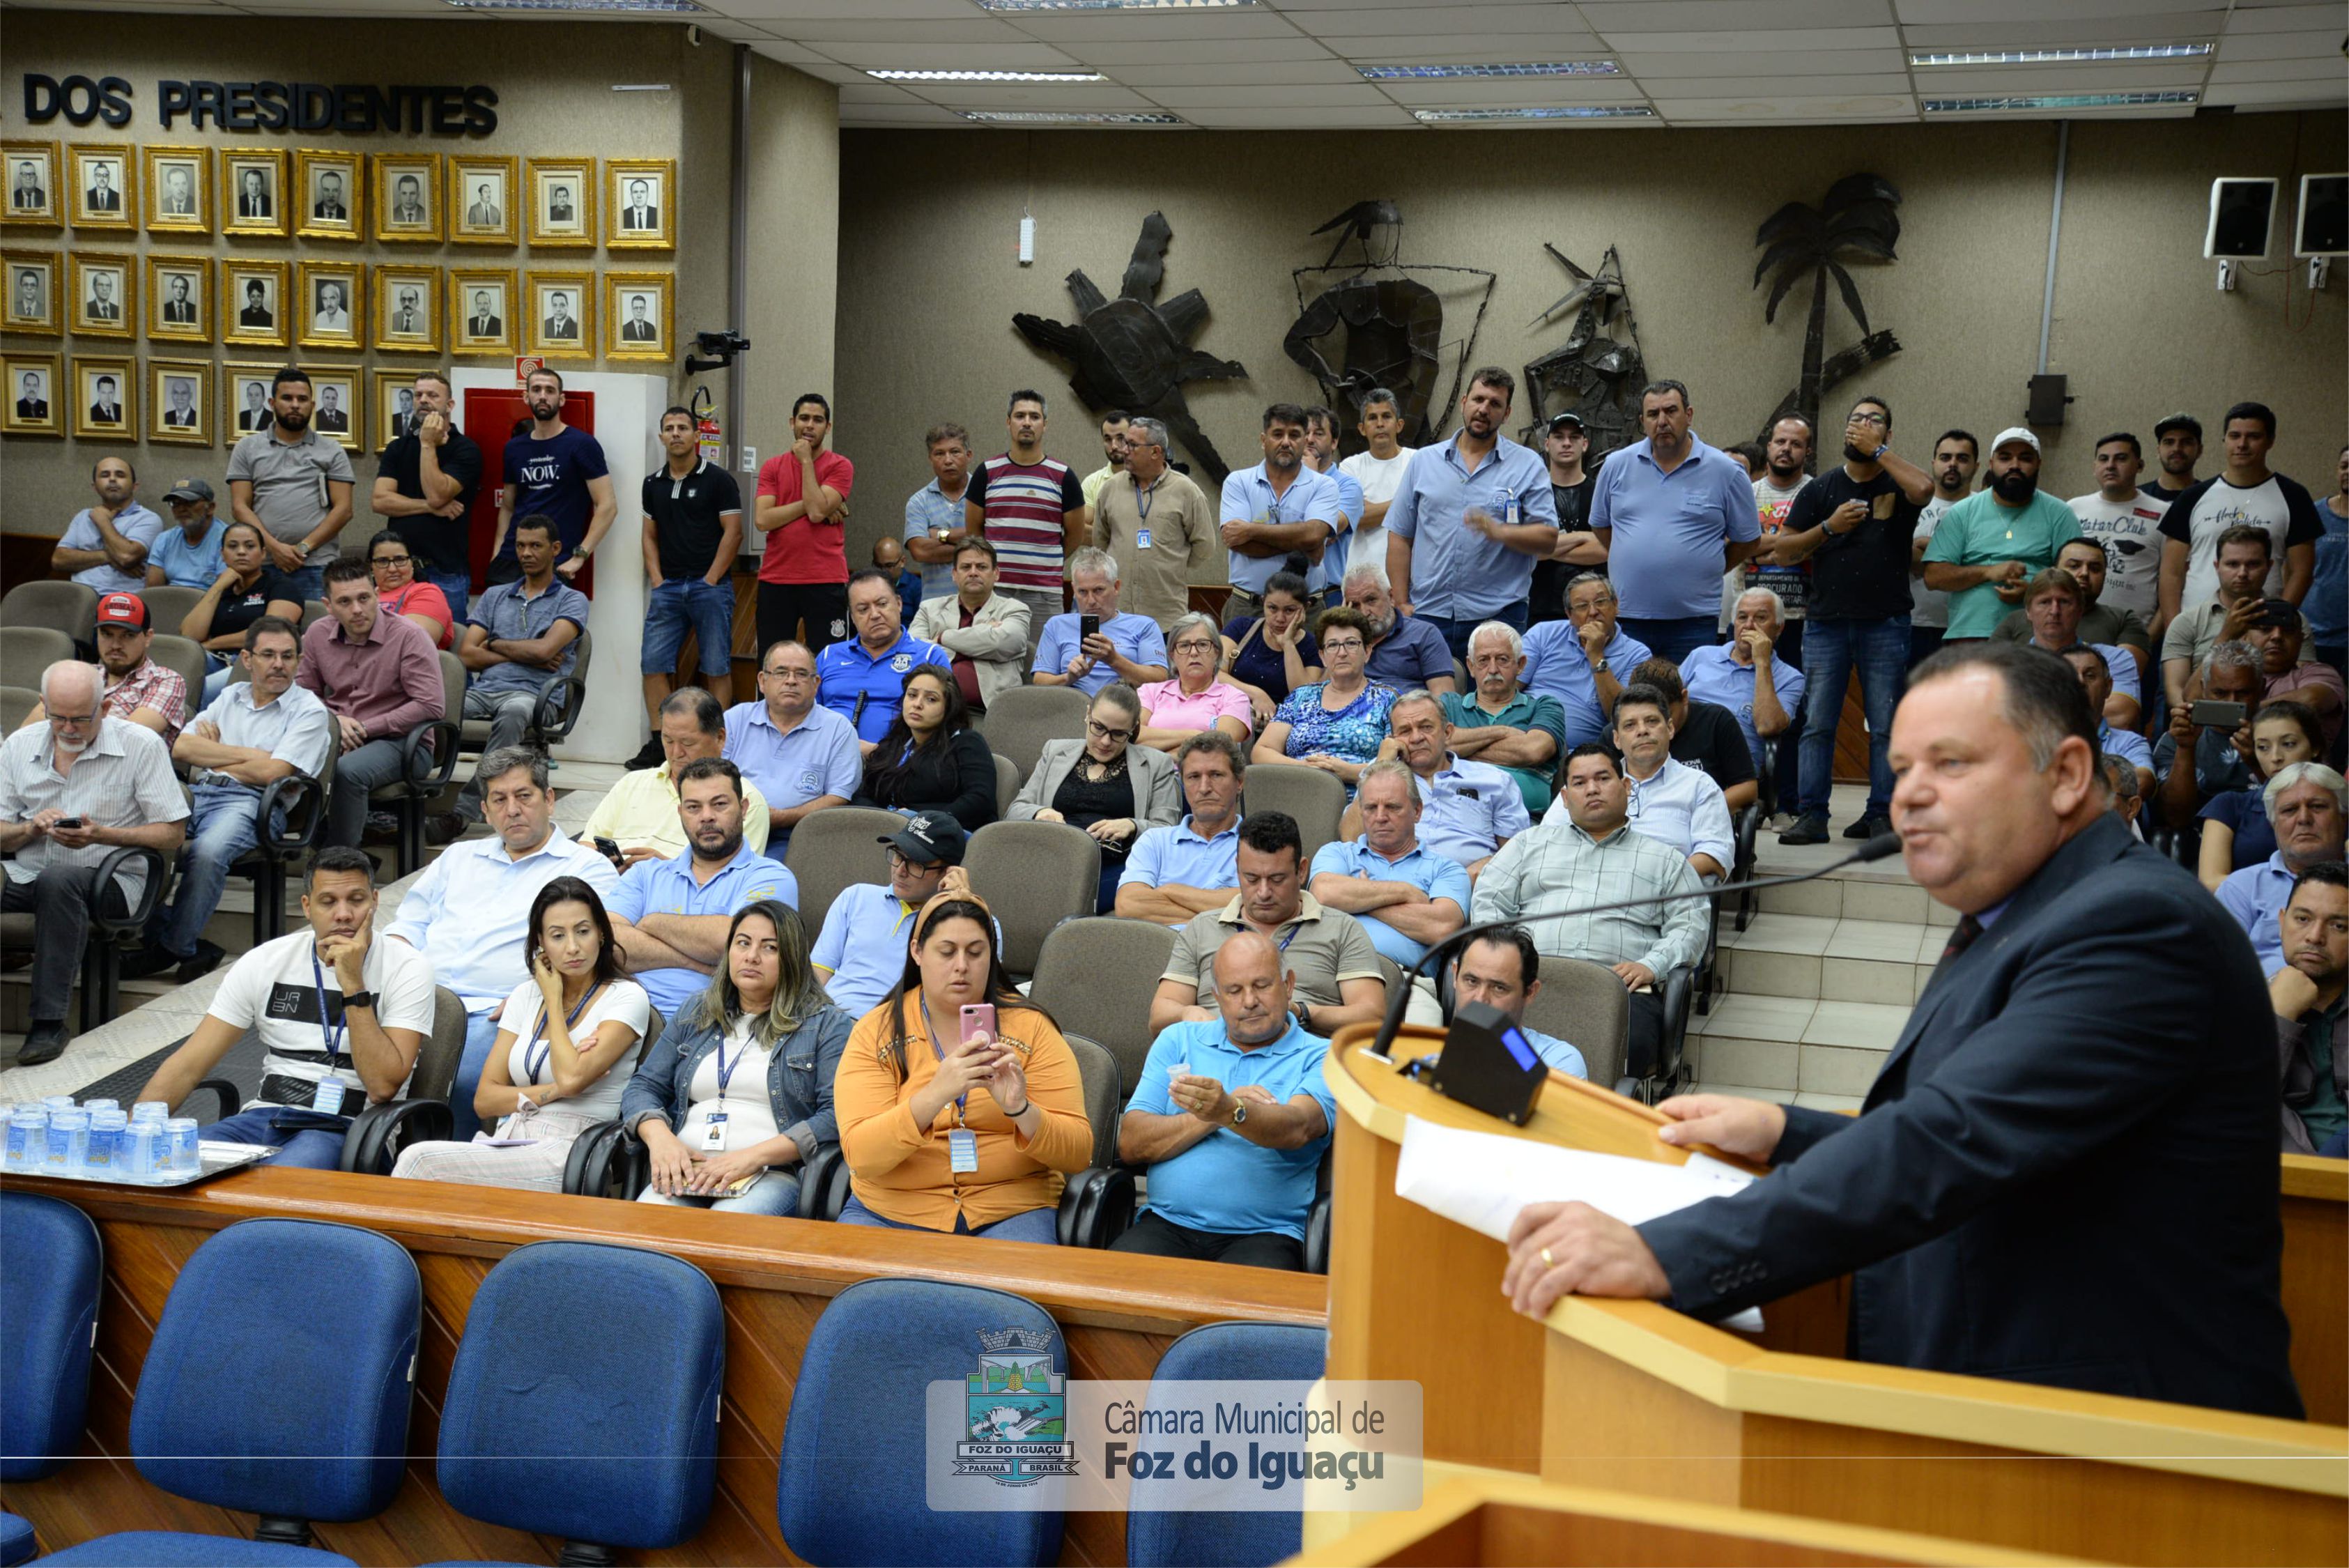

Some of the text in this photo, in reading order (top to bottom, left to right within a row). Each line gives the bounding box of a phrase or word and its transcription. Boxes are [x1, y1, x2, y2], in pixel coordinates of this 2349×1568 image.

[24, 73, 499, 138] DOS PRESIDENTES
[521, 465, 560, 482] NOW.
[275, 990, 300, 1002] UR
